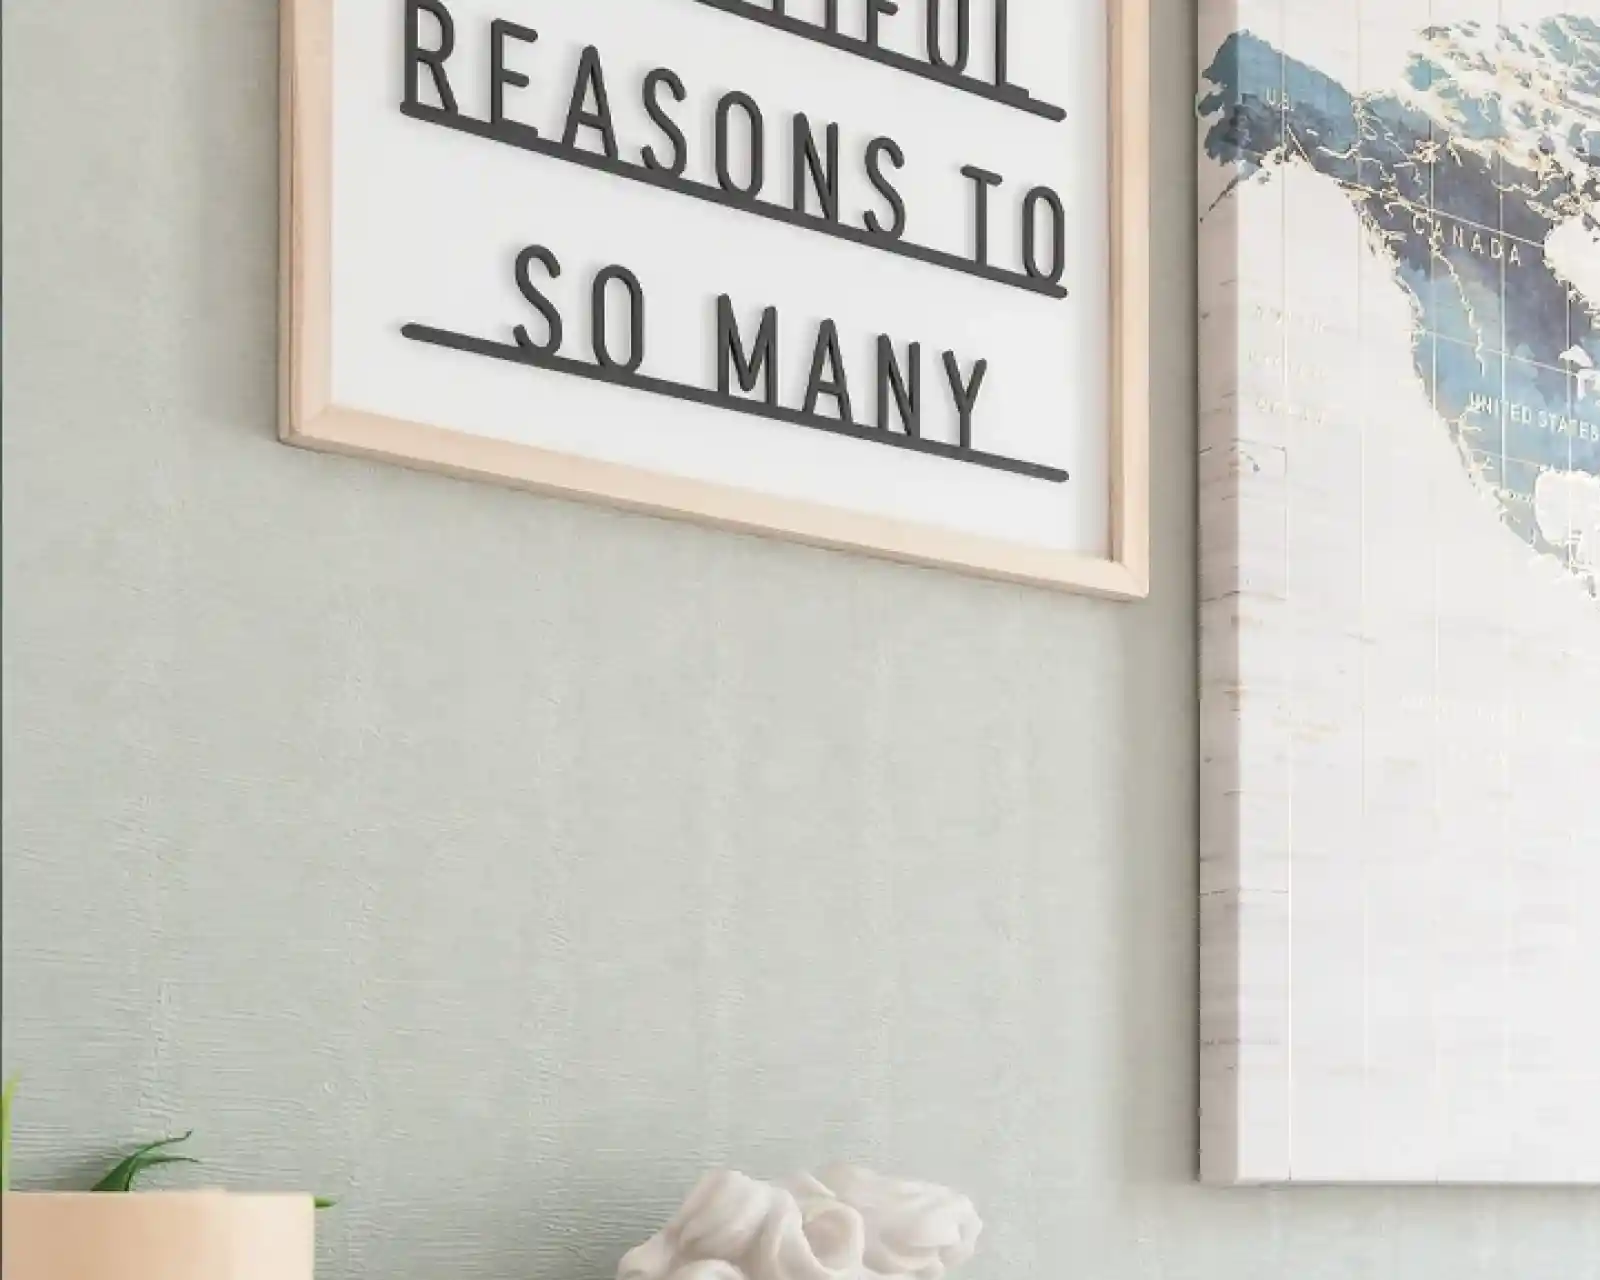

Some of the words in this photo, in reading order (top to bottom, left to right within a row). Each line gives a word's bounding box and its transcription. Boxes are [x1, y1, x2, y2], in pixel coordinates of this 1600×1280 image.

[404, 1, 906, 241] REASONS
[960, 165, 1065, 283] TO
[1412, 211, 1521, 267] CANADA
[513, 244, 643, 377] SO
[718, 293, 988, 450] MANY
[1469, 391, 1532, 426] UNITED
